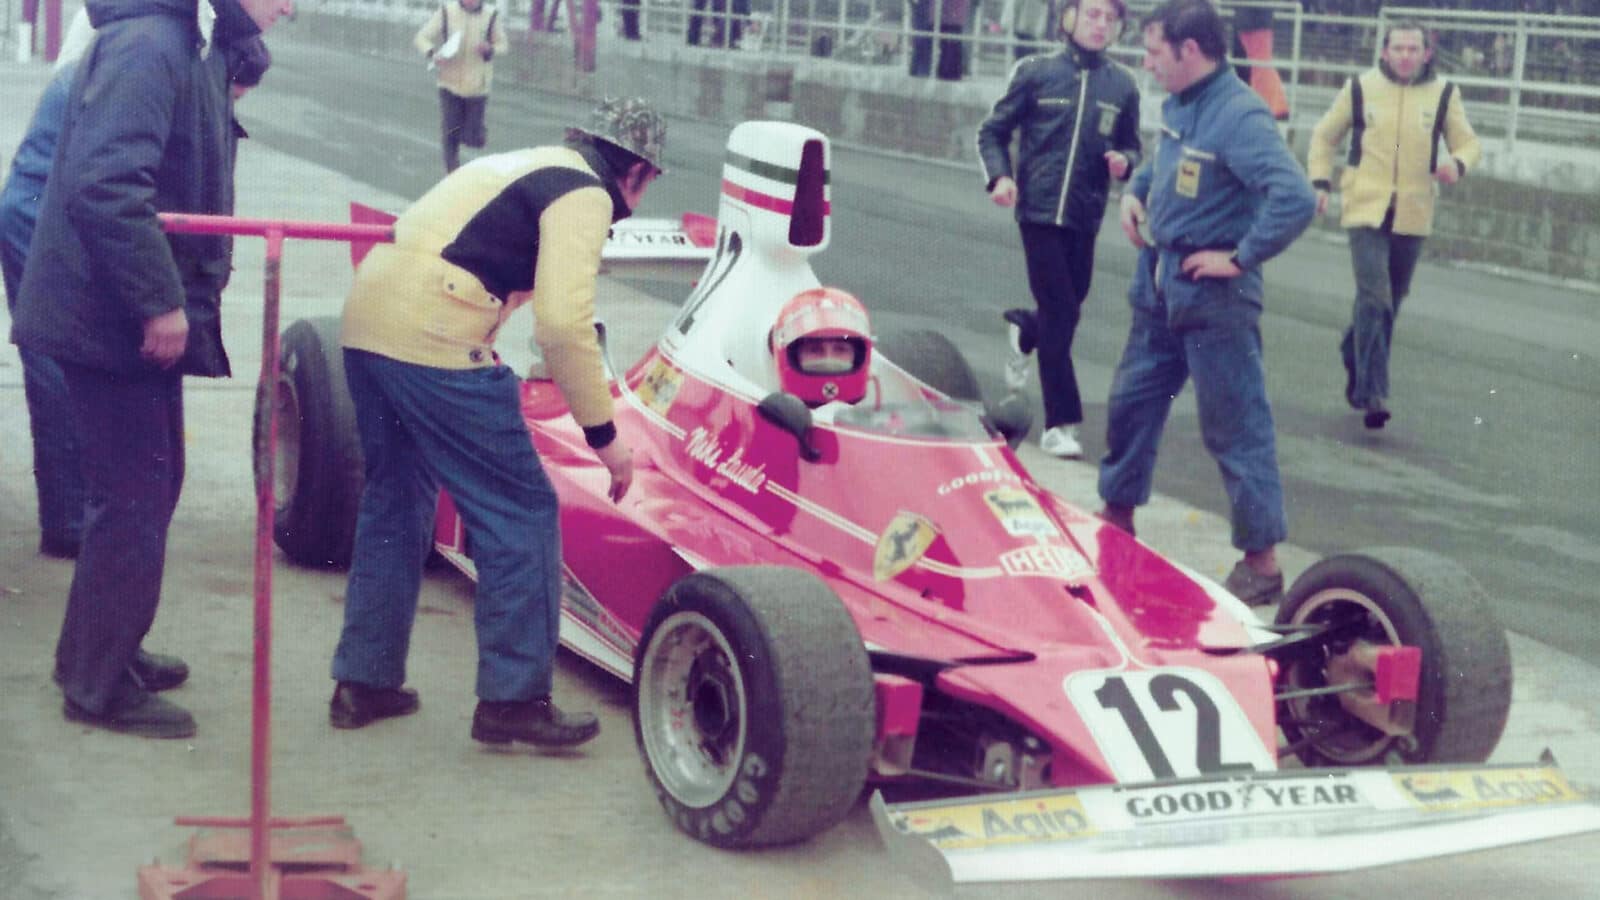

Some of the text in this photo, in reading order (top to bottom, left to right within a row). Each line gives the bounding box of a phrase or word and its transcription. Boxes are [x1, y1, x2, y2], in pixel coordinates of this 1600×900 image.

[1093, 673, 1255, 781] 12
[983, 802, 1089, 839] Agip
[1126, 790, 1233, 818] GOOD
[1263, 784, 1358, 807] YEAR
